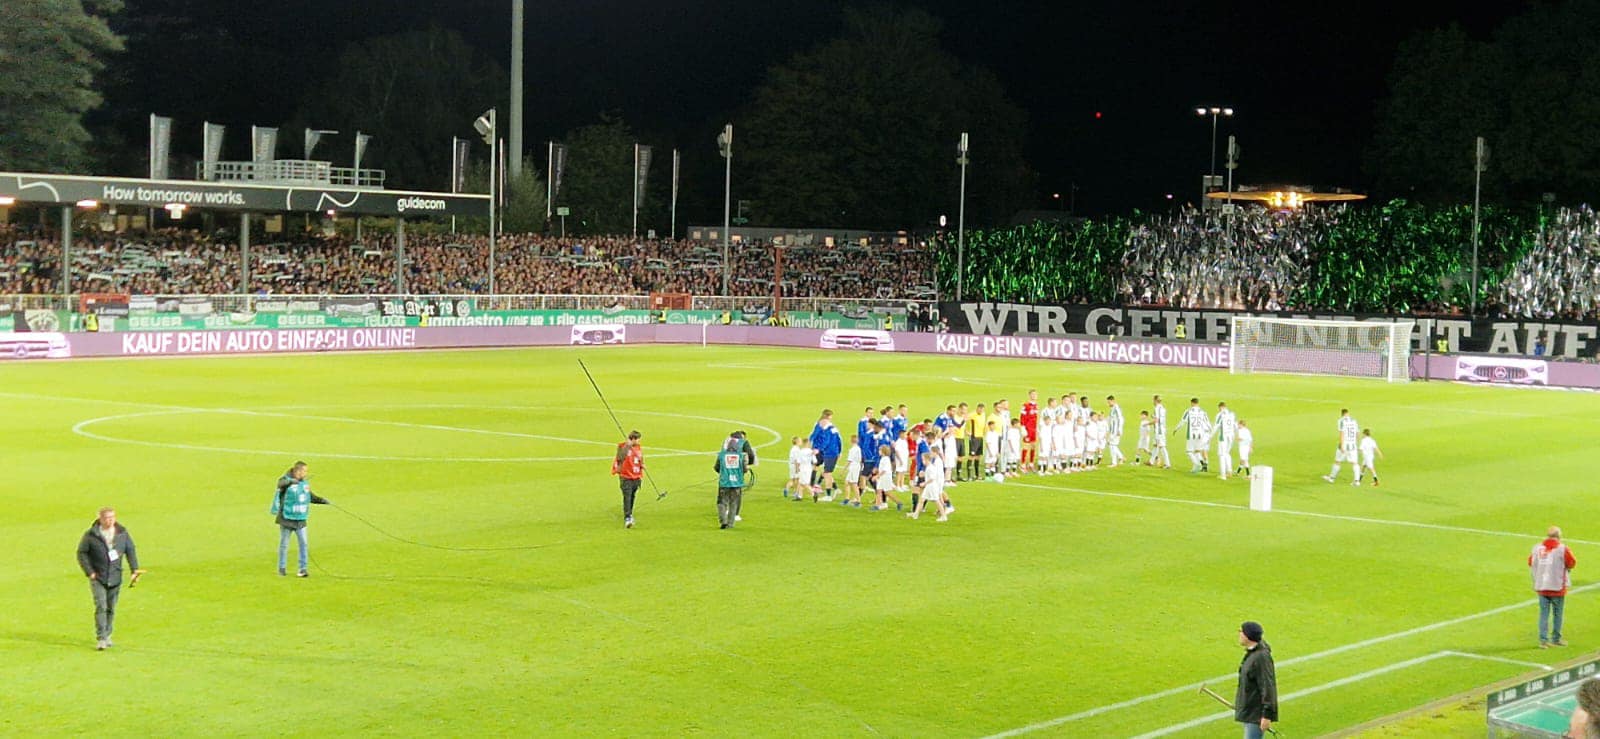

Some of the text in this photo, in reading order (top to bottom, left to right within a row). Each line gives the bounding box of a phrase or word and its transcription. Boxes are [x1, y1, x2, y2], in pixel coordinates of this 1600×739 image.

[103, 186, 245, 204] How tomorrow works.
[397, 197, 446, 212] guidecom
[122, 328, 416, 353] KAUF DEIN AUTO EINFACH ONLINE!
[960, 303, 1067, 335] WIR
[1487, 322, 1597, 358] AUF
[936, 335, 979, 353] KAUF
[983, 337, 1023, 355] DEIN
[1027, 339, 1074, 358] AUTO
[1079, 341, 1153, 362] EINFACH
